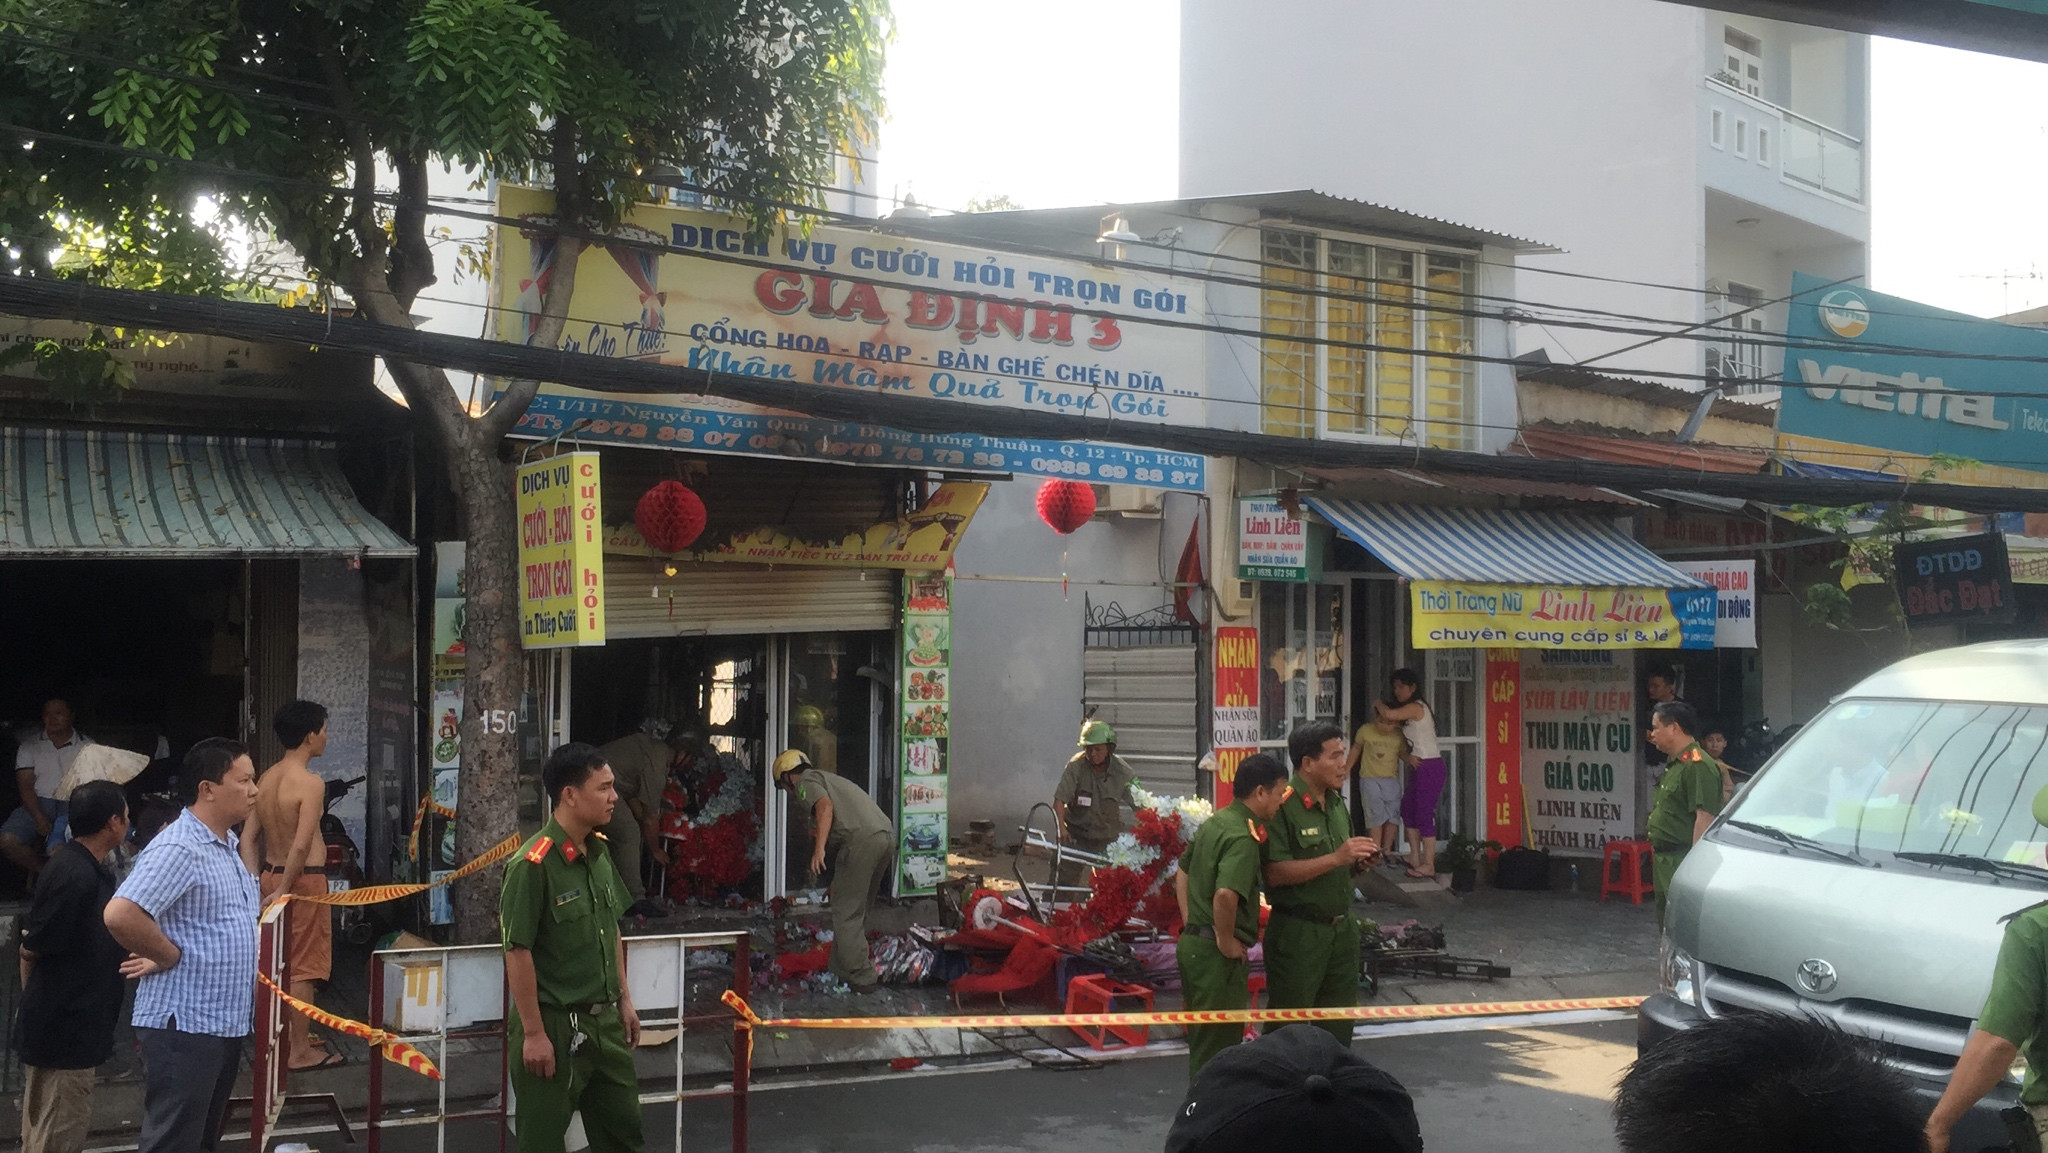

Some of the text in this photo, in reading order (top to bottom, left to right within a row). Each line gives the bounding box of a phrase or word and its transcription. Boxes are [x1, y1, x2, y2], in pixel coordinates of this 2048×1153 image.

[787, 237, 837, 272] VỤ
[851, 246, 940, 279] CƯỚI
[953, 255, 1015, 289] HỎI
[1028, 270, 1121, 306] TRỌN
[1133, 286, 1187, 314] GÓI
[755, 268, 1122, 351] GIA ĐỊNH 3
[690, 316, 768, 350] CỔNG
[777, 331, 831, 354] HOA
[860, 341, 912, 364] RẠP
[937, 348, 989, 372] BÀN
[997, 355, 1049, 379] GHẾ
[1055, 362, 1121, 386] CHÉN
[1128, 370, 1164, 393] DĨA
[813, 357, 916, 392] Mâm
[929, 371, 1004, 400] Quả
[1018, 380, 1099, 416] Trọn
[1111, 392, 1170, 418] Gói
[620, 404, 709, 427] Nguyễn
[716, 413, 758, 431] Văn
[919, 433, 973, 448] Hưng
[979, 434, 1042, 454] Thuận
[1060, 446, 1079, 459] Q.
[1086, 448, 1105, 460] 12
[1121, 451, 1150, 466] Tp.
[1155, 454, 1199, 469] HCM
[703, 431, 742, 448] 07
[522, 464, 571, 497] DỊCH VỤ
[554, 494, 572, 545] HỎI
[1246, 516, 1301, 535] Linh Liên
[748, 547, 786, 560] NHẬN
[526, 550, 572, 607] TRỌN GÓI
[1732, 570, 1748, 591] CAO
[1420, 588, 1451, 612] Thời
[1454, 590, 1498, 616] Trang
[1502, 592, 1523, 612] Nữ
[1530, 589, 1598, 623] Linh
[1602, 590, 1663, 624] Liên
[1728, 595, 1751, 623] ĐỘNG
[525, 608, 577, 639] in Thiệp Cưới
[1429, 626, 1508, 644] chuyên
[1511, 629, 1565, 645] cung
[1570, 625, 1610, 647] cấp
[1615, 627, 1630, 643] sỉ
[1634, 628, 1649, 643] &
[1219, 631, 1256, 678] NHẬN
[1492, 670, 1515, 703] CẤP
[480, 709, 516, 735] 150
[1214, 725, 1258, 746] QUẦN ÁO
[1498, 712, 1509, 744] SỈ
[1526, 716, 1632, 753] THU MÁY CŨ
[1498, 761, 1507, 785] &
[1544, 755, 1615, 793] GIÁ CAO
[1496, 793, 1510, 826] LẺ
[1537, 797, 1622, 827] LINH KIỆN
